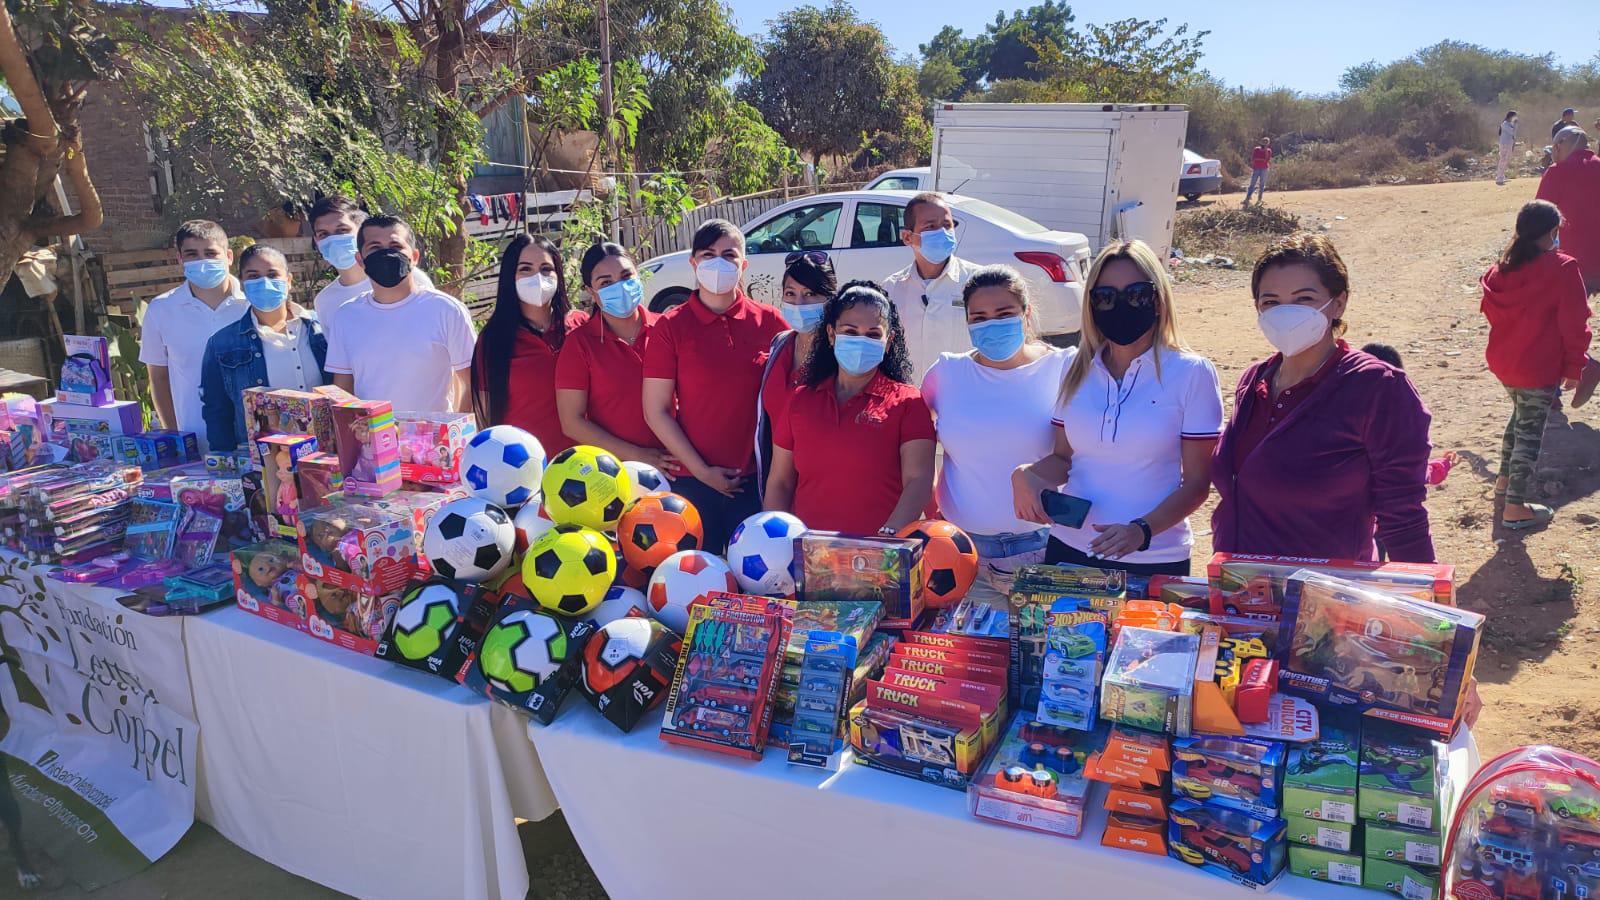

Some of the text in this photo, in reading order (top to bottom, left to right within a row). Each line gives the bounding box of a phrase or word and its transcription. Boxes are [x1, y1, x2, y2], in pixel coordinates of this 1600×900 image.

[1231, 553, 1331, 564] TRUCK POWER
[725, 611, 766, 624] PROTECTION
[570, 621, 585, 639] Voit
[913, 634, 955, 648] TRUCK
[903, 646, 947, 661] TRUCK
[766, 638, 787, 704] PROTECTION
[900, 658, 945, 676] TRUCK
[666, 662, 686, 712] PROTECTION
[893, 673, 937, 692] TRUCK
[1278, 669, 1330, 687] ADVENTURE
[632, 679, 655, 700] Voit
[876, 687, 919, 708] TRUCK
[1281, 698, 1296, 737] BUILDER
[1296, 710, 1313, 732] CITY
[1400, 714, 1449, 729] DINOSAURIOS
[82, 682, 188, 788] Coppel
